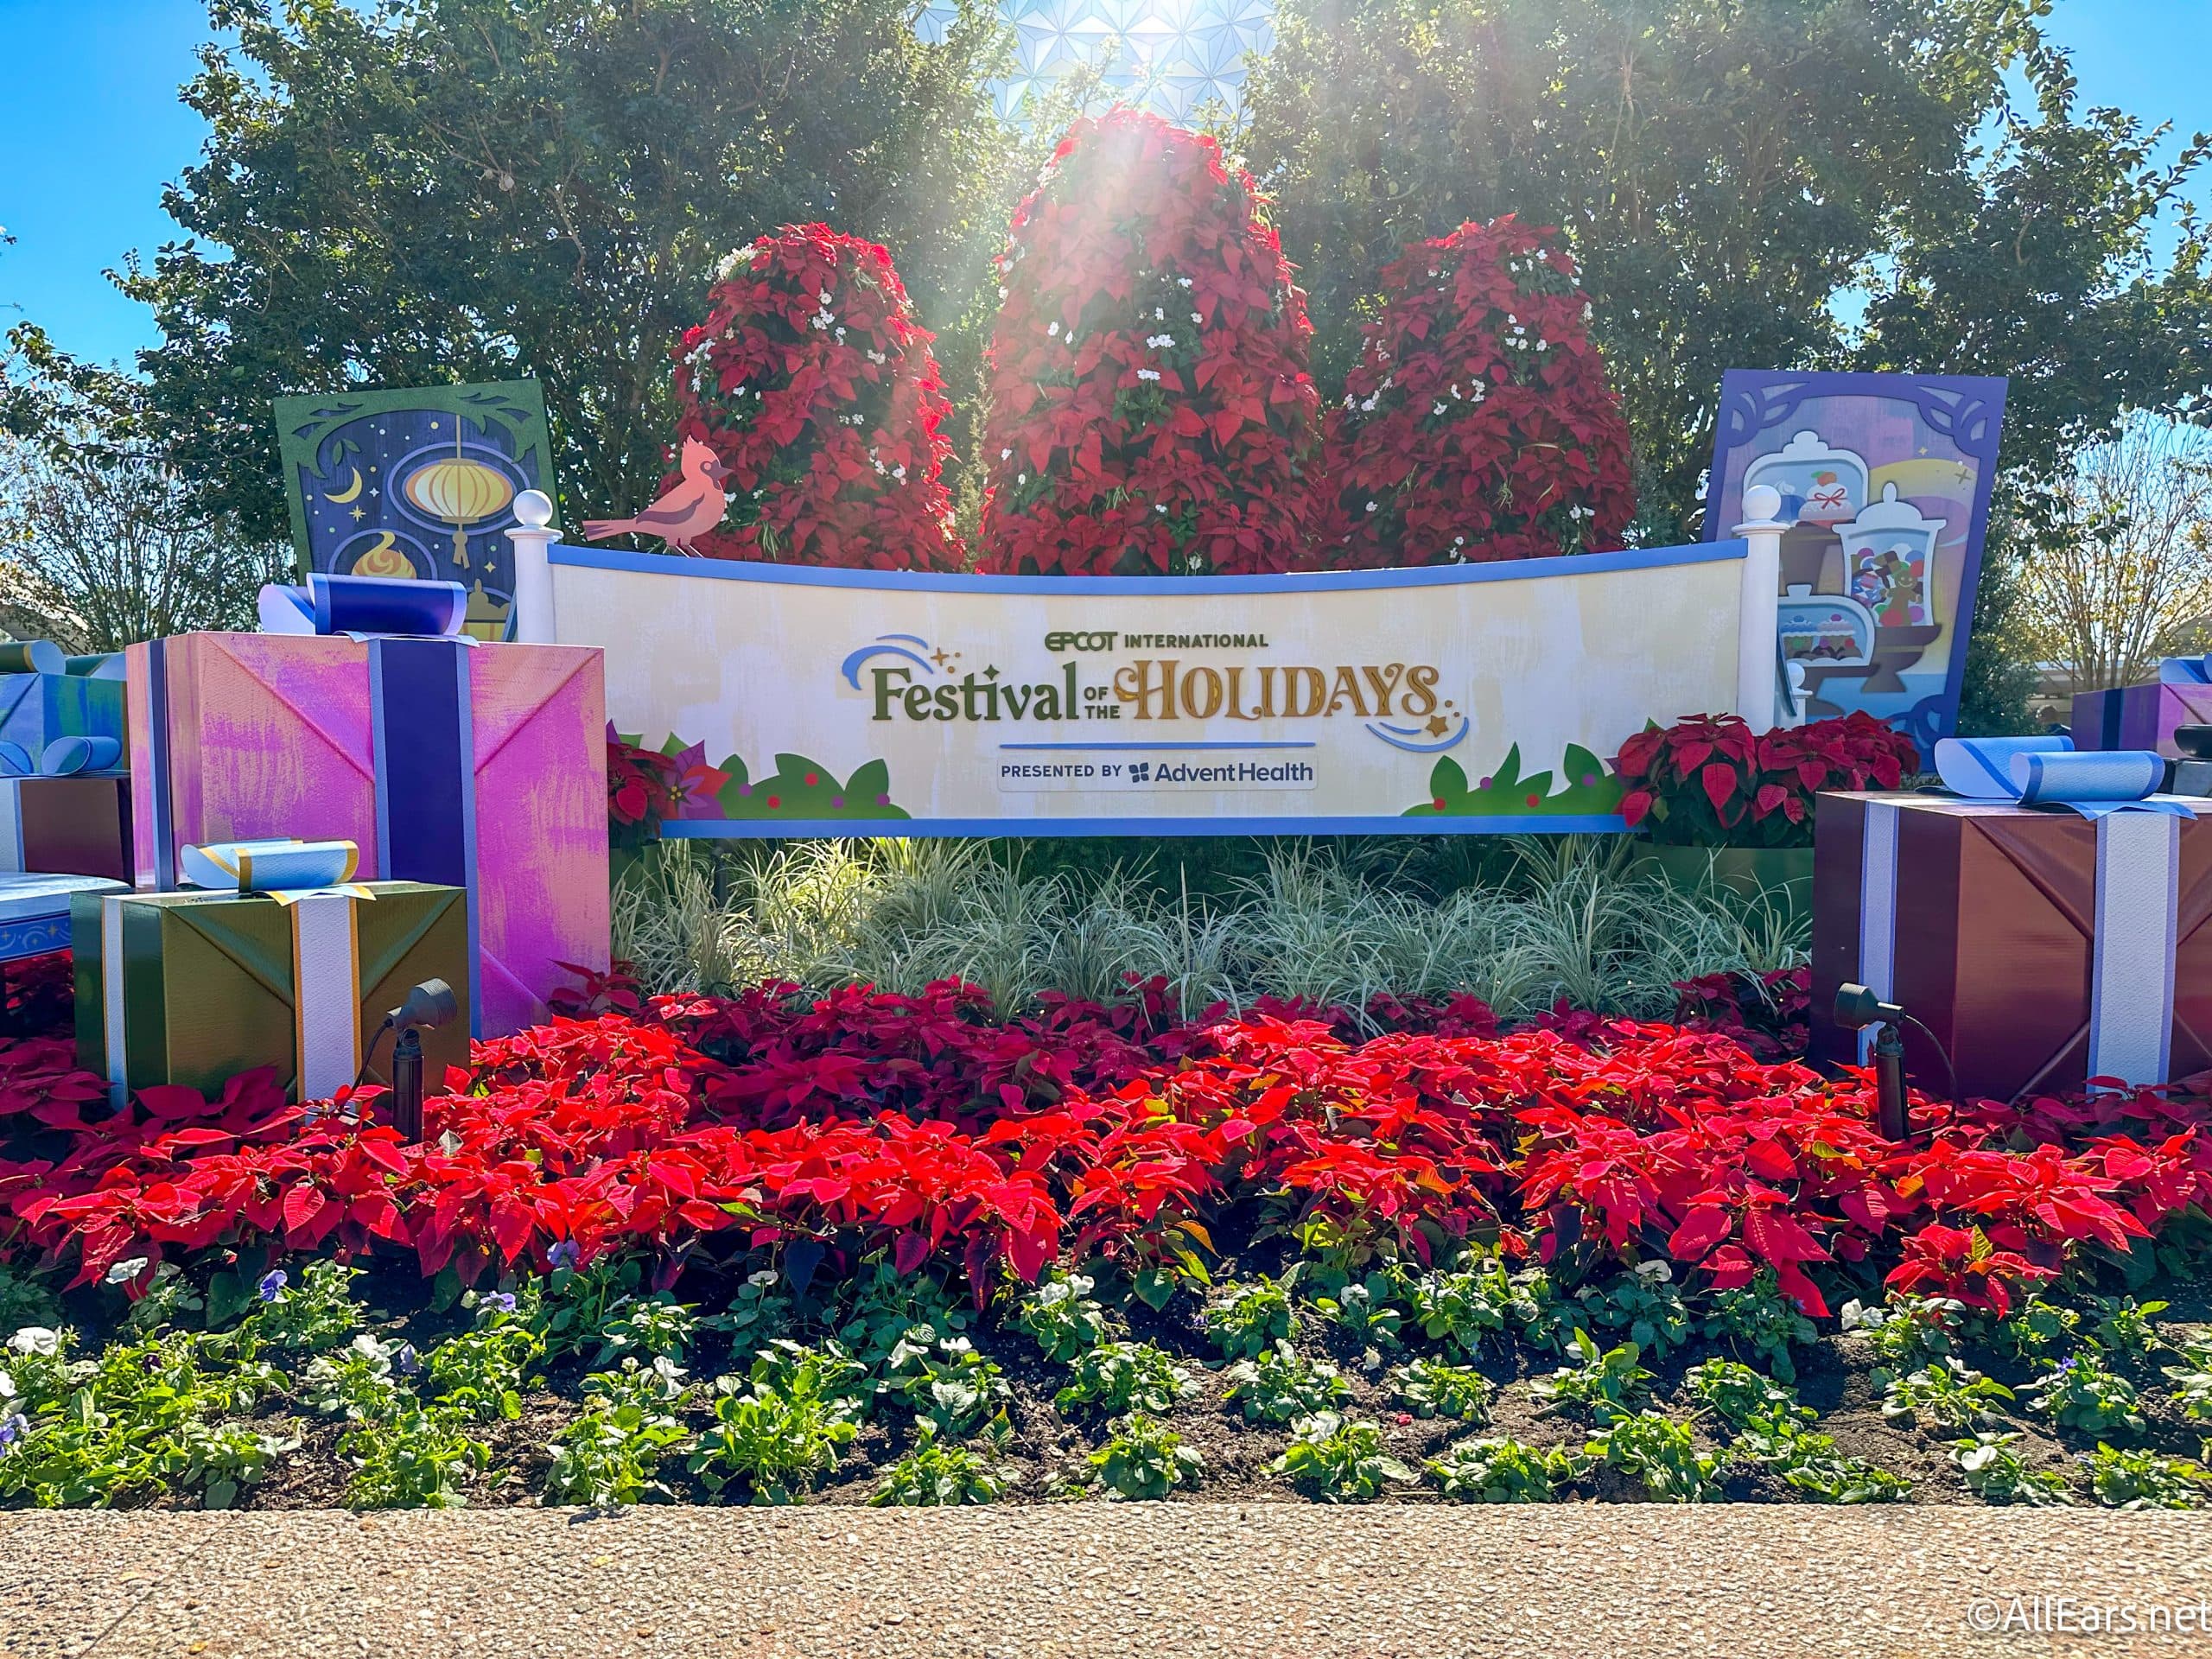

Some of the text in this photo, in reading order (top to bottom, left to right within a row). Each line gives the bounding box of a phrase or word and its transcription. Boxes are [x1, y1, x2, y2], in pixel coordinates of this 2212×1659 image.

[1045, 631, 1269, 652] EPCOT INTERNATIONAL
[870, 661, 1080, 721] Festival
[1084, 687, 1109, 702] OF
[1113, 659, 1440, 721] HOLIDAYS
[1084, 705, 1121, 719] THE
[1001, 765, 1097, 778] PRESENTED
[1102, 765, 1122, 778] BY
